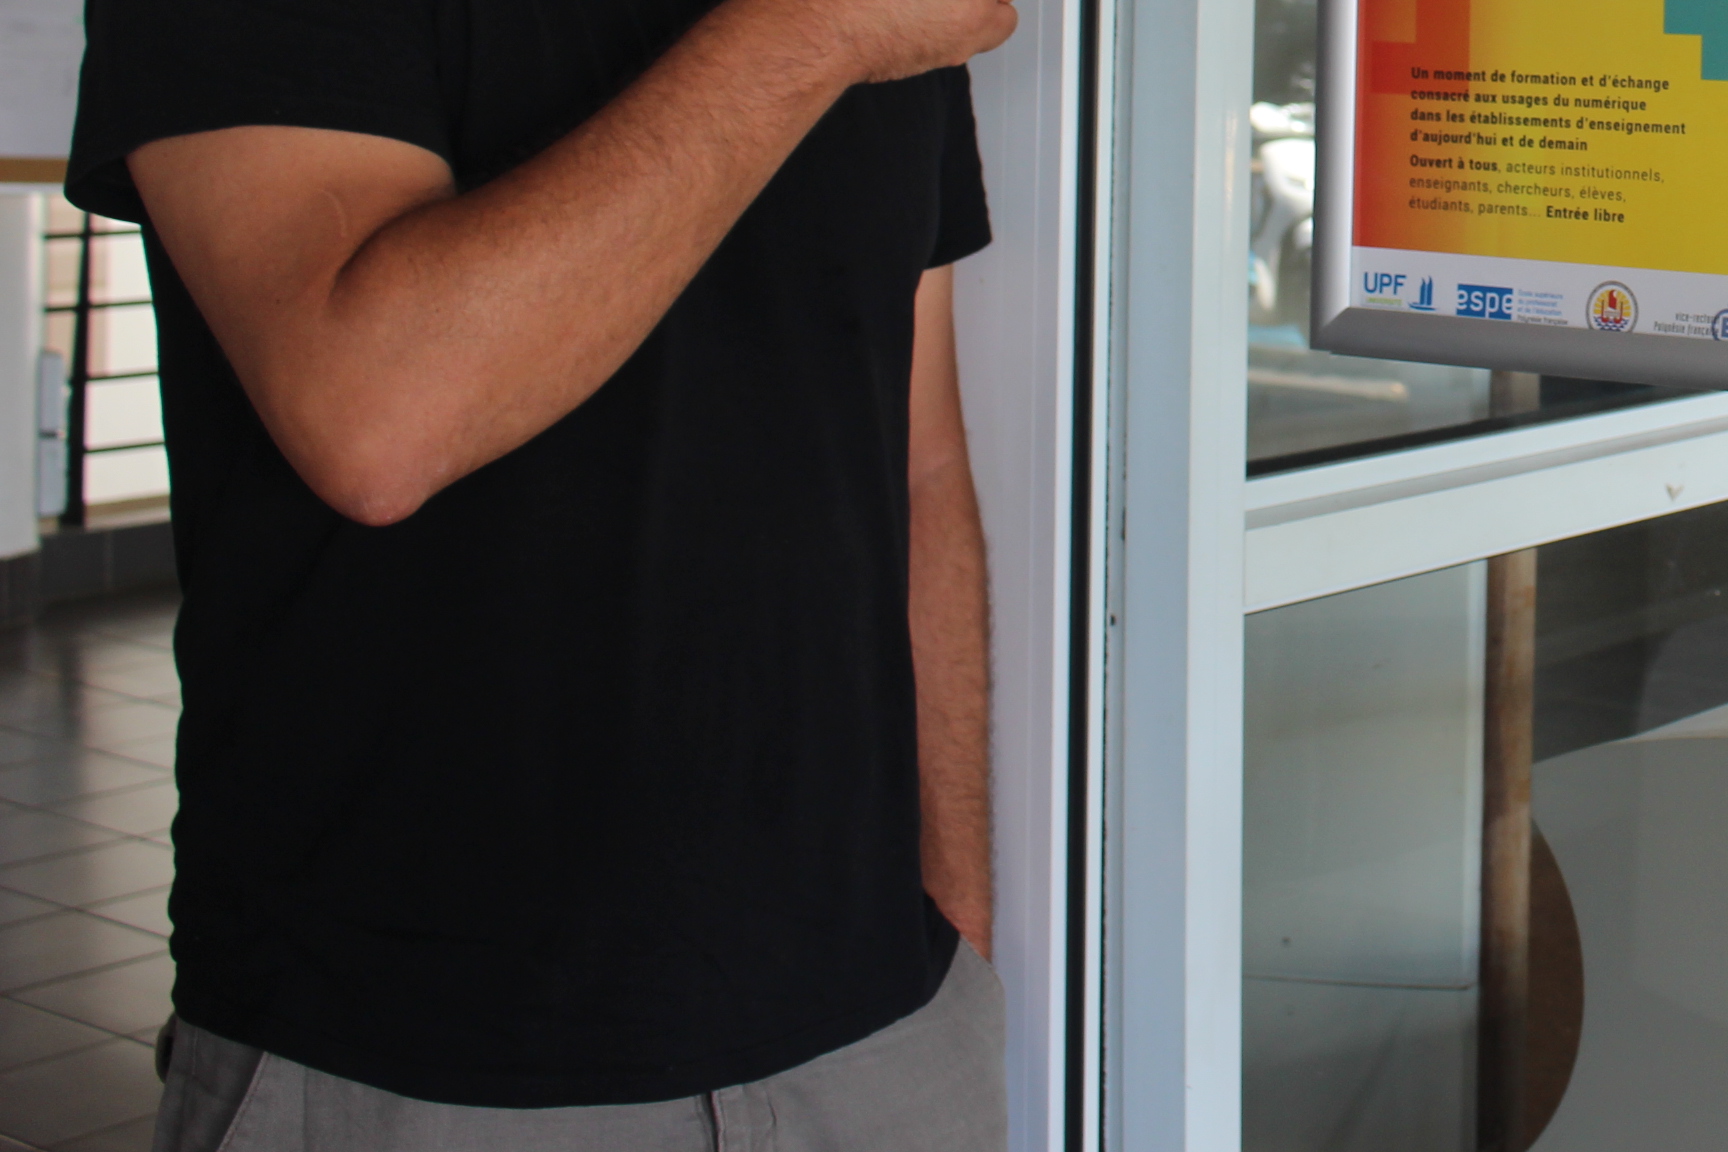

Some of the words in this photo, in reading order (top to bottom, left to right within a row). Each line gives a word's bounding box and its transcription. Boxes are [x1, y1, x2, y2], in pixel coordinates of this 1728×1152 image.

[1411, 66, 1429, 80] Un
[1433, 69, 1486, 82] moment
[1491, 69, 1506, 83] de
[1511, 69, 1576, 86] formation
[1581, 74, 1594, 86] et
[1599, 74, 1669, 92] d'échange
[1410, 89, 1470, 103] consacré
[1474, 92, 1497, 104] aux
[1501, 93, 1548, 108] usages
[1553, 94, 1570, 107] du
[1574, 96, 1646, 113] numérique
[1410, 107, 1441, 122] dans
[1446, 109, 1465, 123] les
[1470, 111, 1571, 128] établissements
[1576, 116, 1686, 135] d'enseignement
[1410, 128, 1497, 146] d'aujourd'hui
[1501, 135, 1514, 147] et
[1519, 135, 1534, 148] de
[1539, 135, 1588, 151] demain
[1410, 154, 1453, 168] Ouvert
[1457, 156, 1465, 169] à
[1469, 159, 1502, 173] tous,
[1506, 161, 1556, 175] acteurs
[1561, 163, 1664, 183] institutionnels,
[1409, 176, 1492, 193] enseignants,
[1497, 181, 1575, 199] chercheurs,
[1579, 185, 1626, 203] élèves,
[1409, 195, 1473, 214] étudiants,
[1546, 205, 1589, 221] Entrée
[1594, 207, 1625, 223] libre
[1364, 272, 1406, 295] UPF
[1457, 289, 1513, 320] espe
